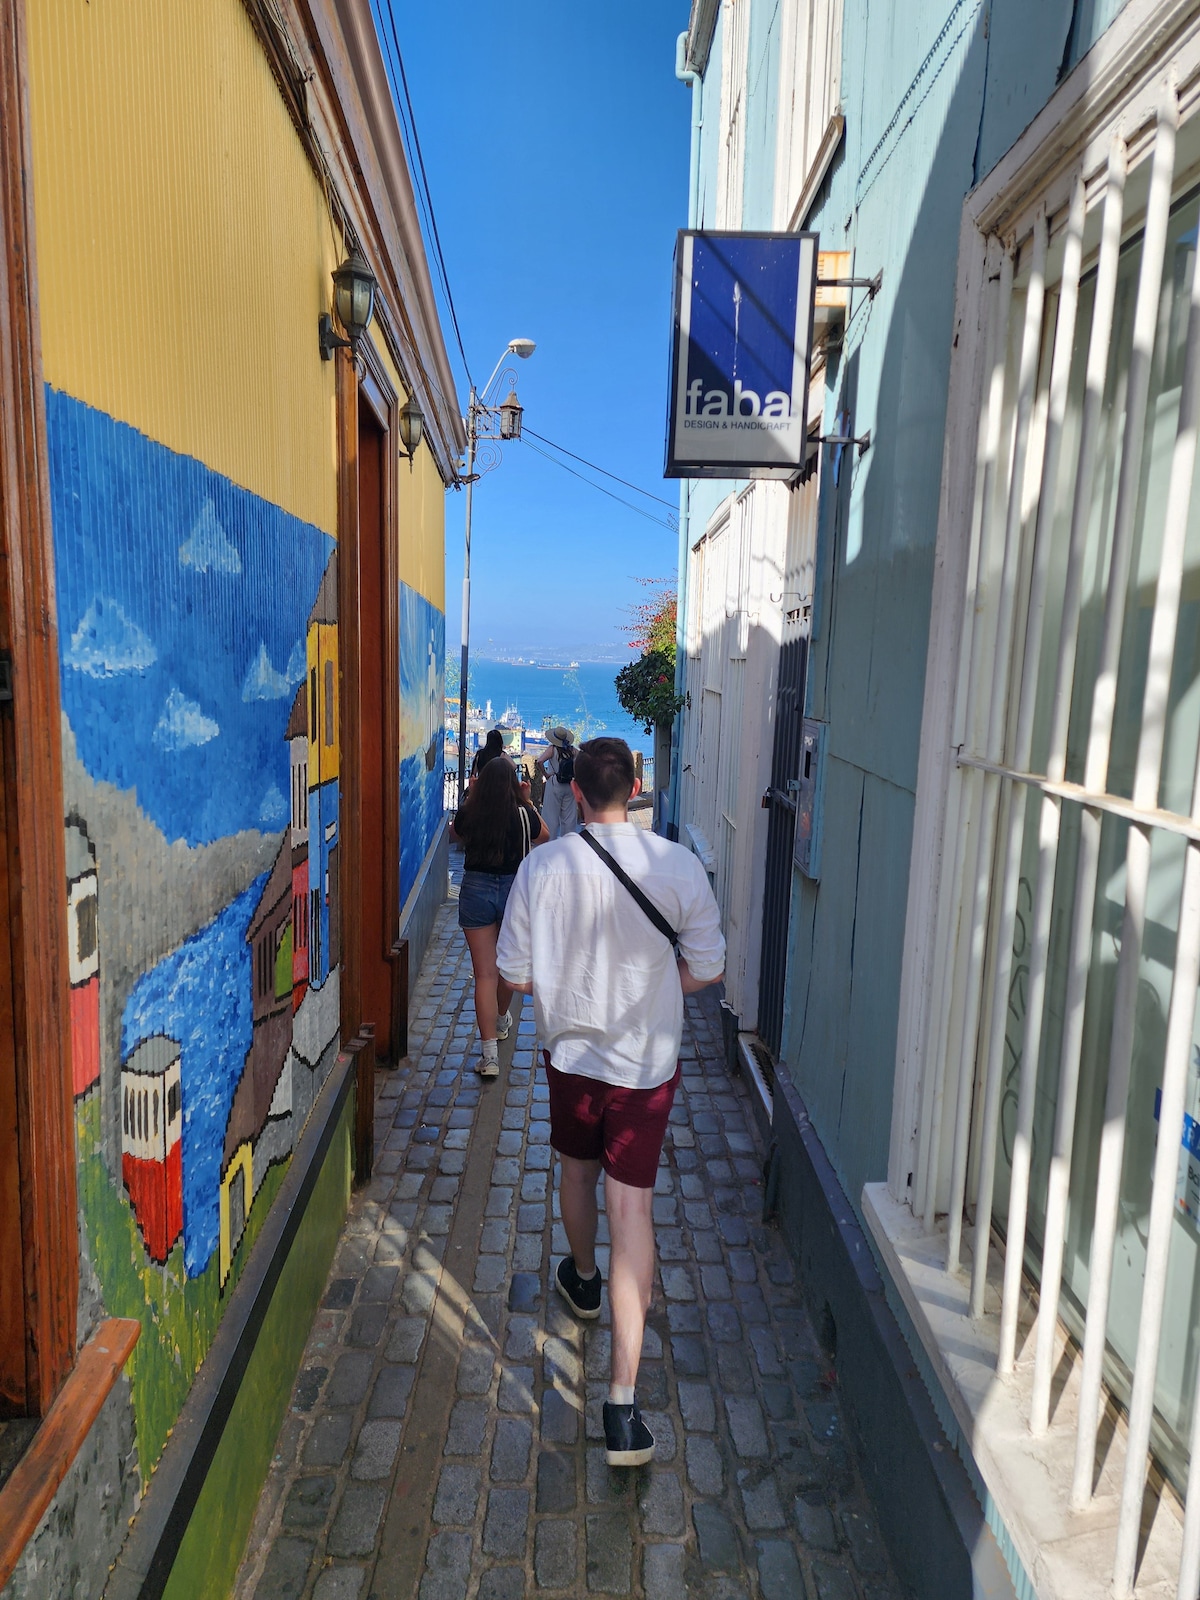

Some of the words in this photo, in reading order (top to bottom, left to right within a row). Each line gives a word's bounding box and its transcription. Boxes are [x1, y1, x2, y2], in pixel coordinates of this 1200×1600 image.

[686, 378, 791, 418] faba
[684, 420, 719, 430] DESIGN
[721, 421, 728, 430] &
[730, 421, 792, 431] HANDICRAFT
